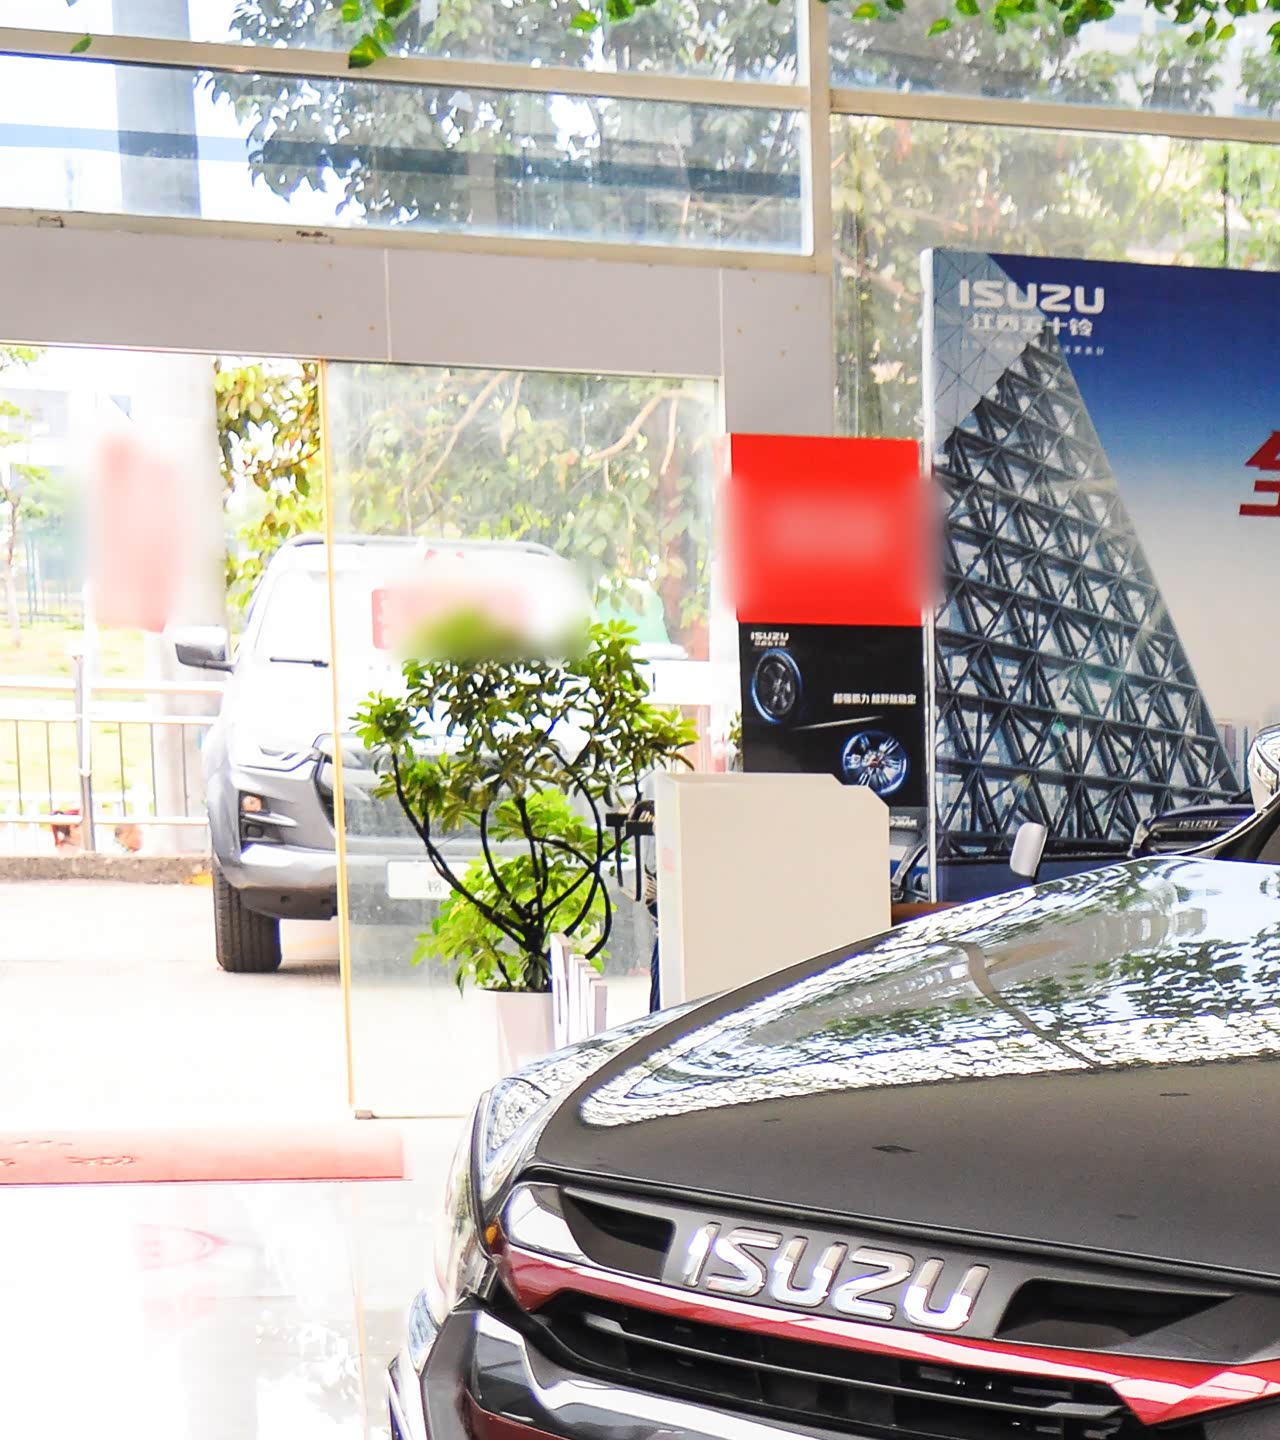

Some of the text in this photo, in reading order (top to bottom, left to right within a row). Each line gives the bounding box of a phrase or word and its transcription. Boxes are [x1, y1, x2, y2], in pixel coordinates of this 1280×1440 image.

[959, 279, 1105, 314] ISUZU
[750, 631, 790, 642] ISUZU
[1179, 820, 1219, 830] ISUZU
[682, 1221, 991, 1331] ISUZU
